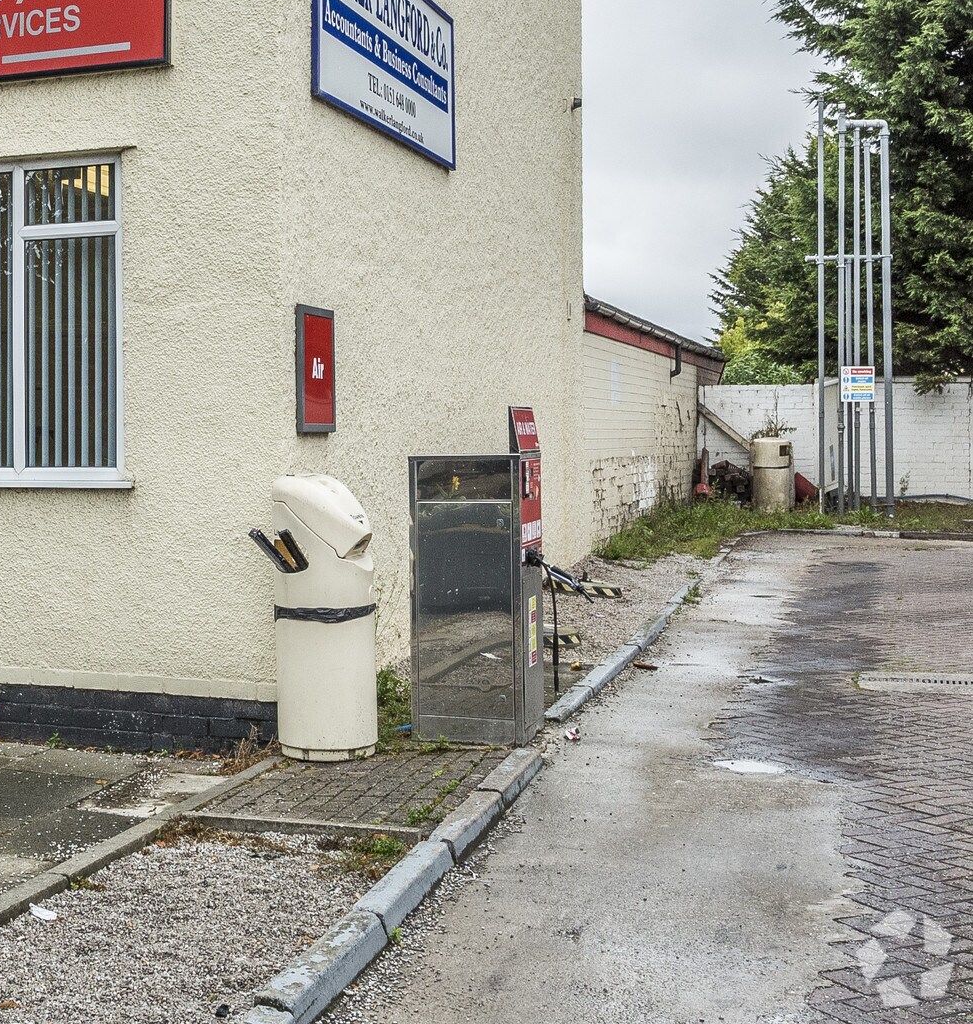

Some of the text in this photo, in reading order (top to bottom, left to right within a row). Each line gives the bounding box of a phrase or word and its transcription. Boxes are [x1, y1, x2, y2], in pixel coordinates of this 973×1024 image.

[374, 33, 382, 58] &
[381, 38, 412, 79] Business
[411, 62, 447, 106] Consultants
[312, 357, 324, 379] Air
